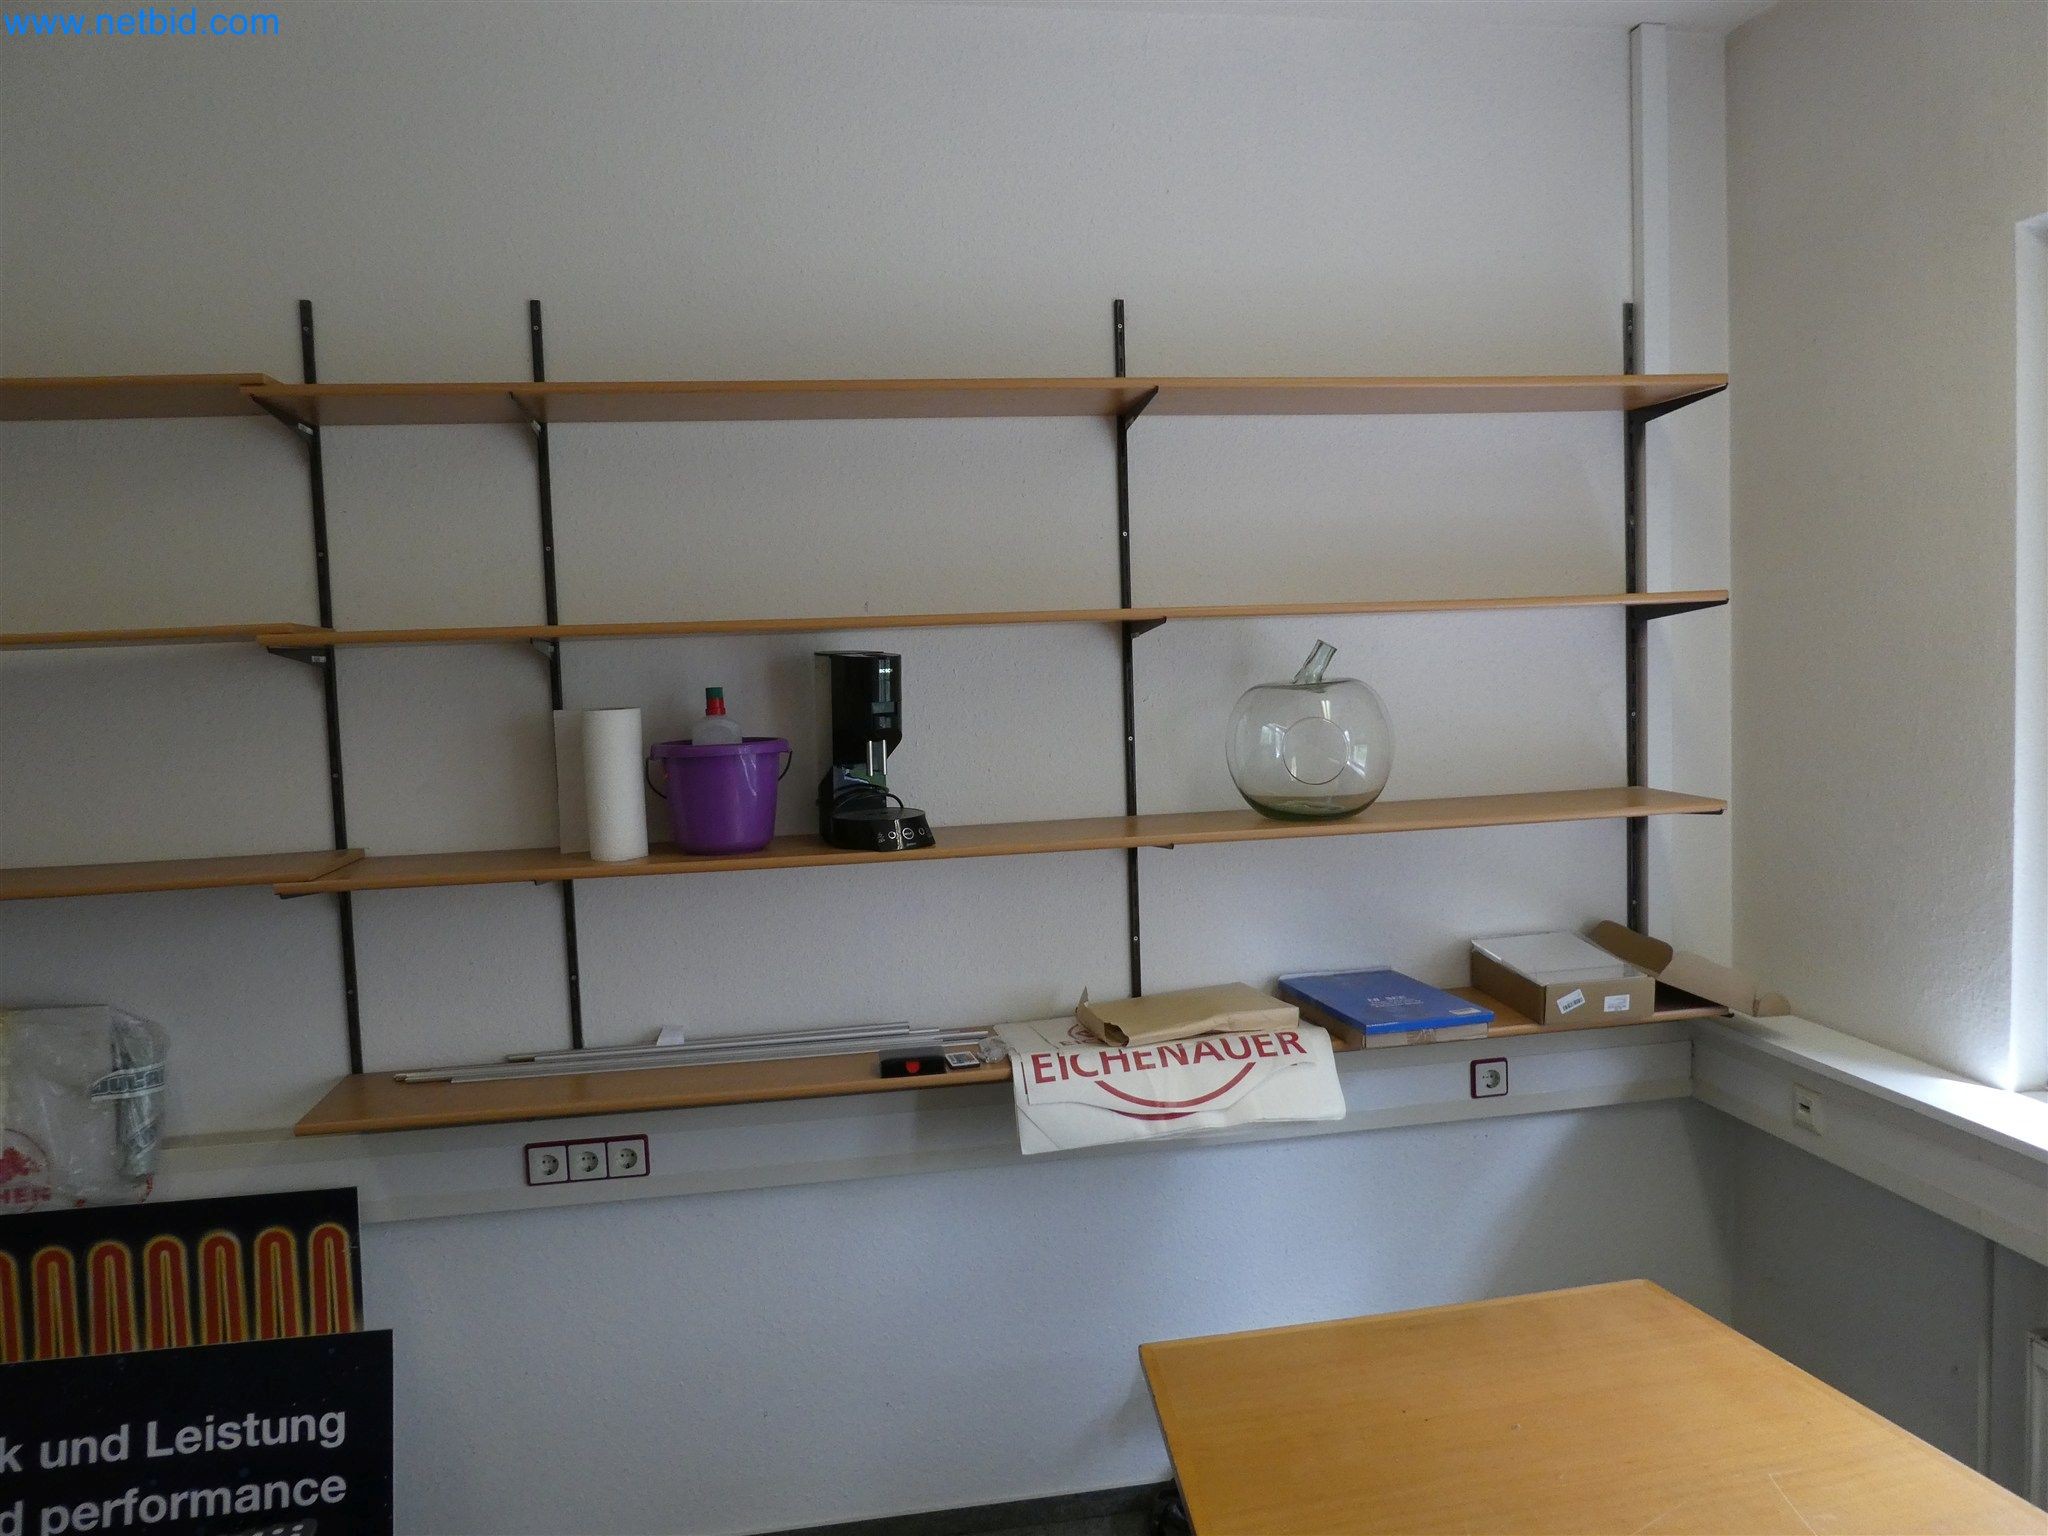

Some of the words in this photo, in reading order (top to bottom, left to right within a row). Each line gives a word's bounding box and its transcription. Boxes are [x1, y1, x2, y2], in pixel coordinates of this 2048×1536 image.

[1031, 1031, 1308, 1084] EICHENAUER
[40, 1424, 129, 1470] und
[147, 1410, 346, 1458] Leistung
[41, 1475, 347, 1536] performance
